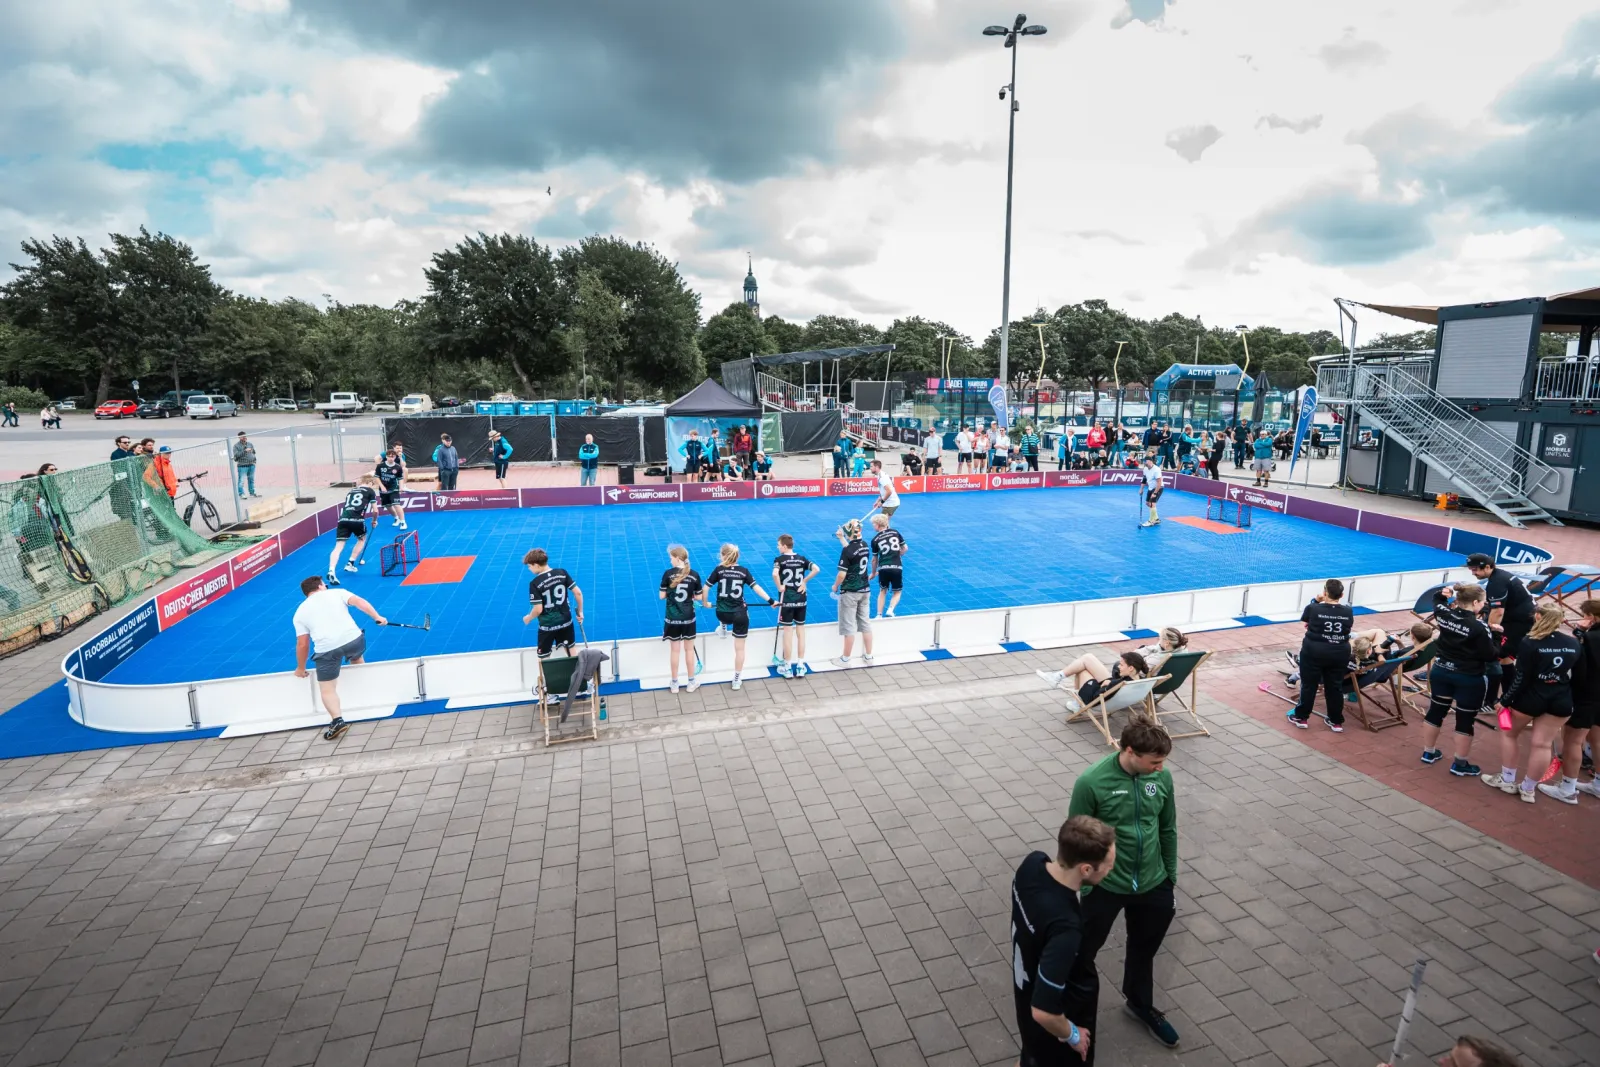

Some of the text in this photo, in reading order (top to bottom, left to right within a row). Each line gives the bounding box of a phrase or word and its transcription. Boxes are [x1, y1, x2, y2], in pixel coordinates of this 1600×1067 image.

[628, 491, 679, 500] CHAMPIONSHIPS
[701, 485, 727, 494] nordic
[711, 489, 737, 498] minds
[344, 492, 364, 508] 18
[1244, 494, 1284, 509] CHAMPIONSHIPS
[877, 536, 901, 555] 58
[858, 556, 869, 575] 9
[782, 568, 804, 587] 25
[163, 586, 204, 619] DEUTSCHER
[203, 573, 229, 597] MEISTER
[541, 584, 566, 609] 19
[674, 583, 689, 602] 5
[719, 578, 743, 599] 15
[84, 630, 118, 661] FLOORBALL
[117, 623, 128, 636] WO
[127, 616, 136, 630] DU
[135, 605, 155, 624] WILLST.
[1323, 621, 1343, 633] 33
[1552, 656, 1564, 669] 9
[1145, 784, 1156, 794] 96
